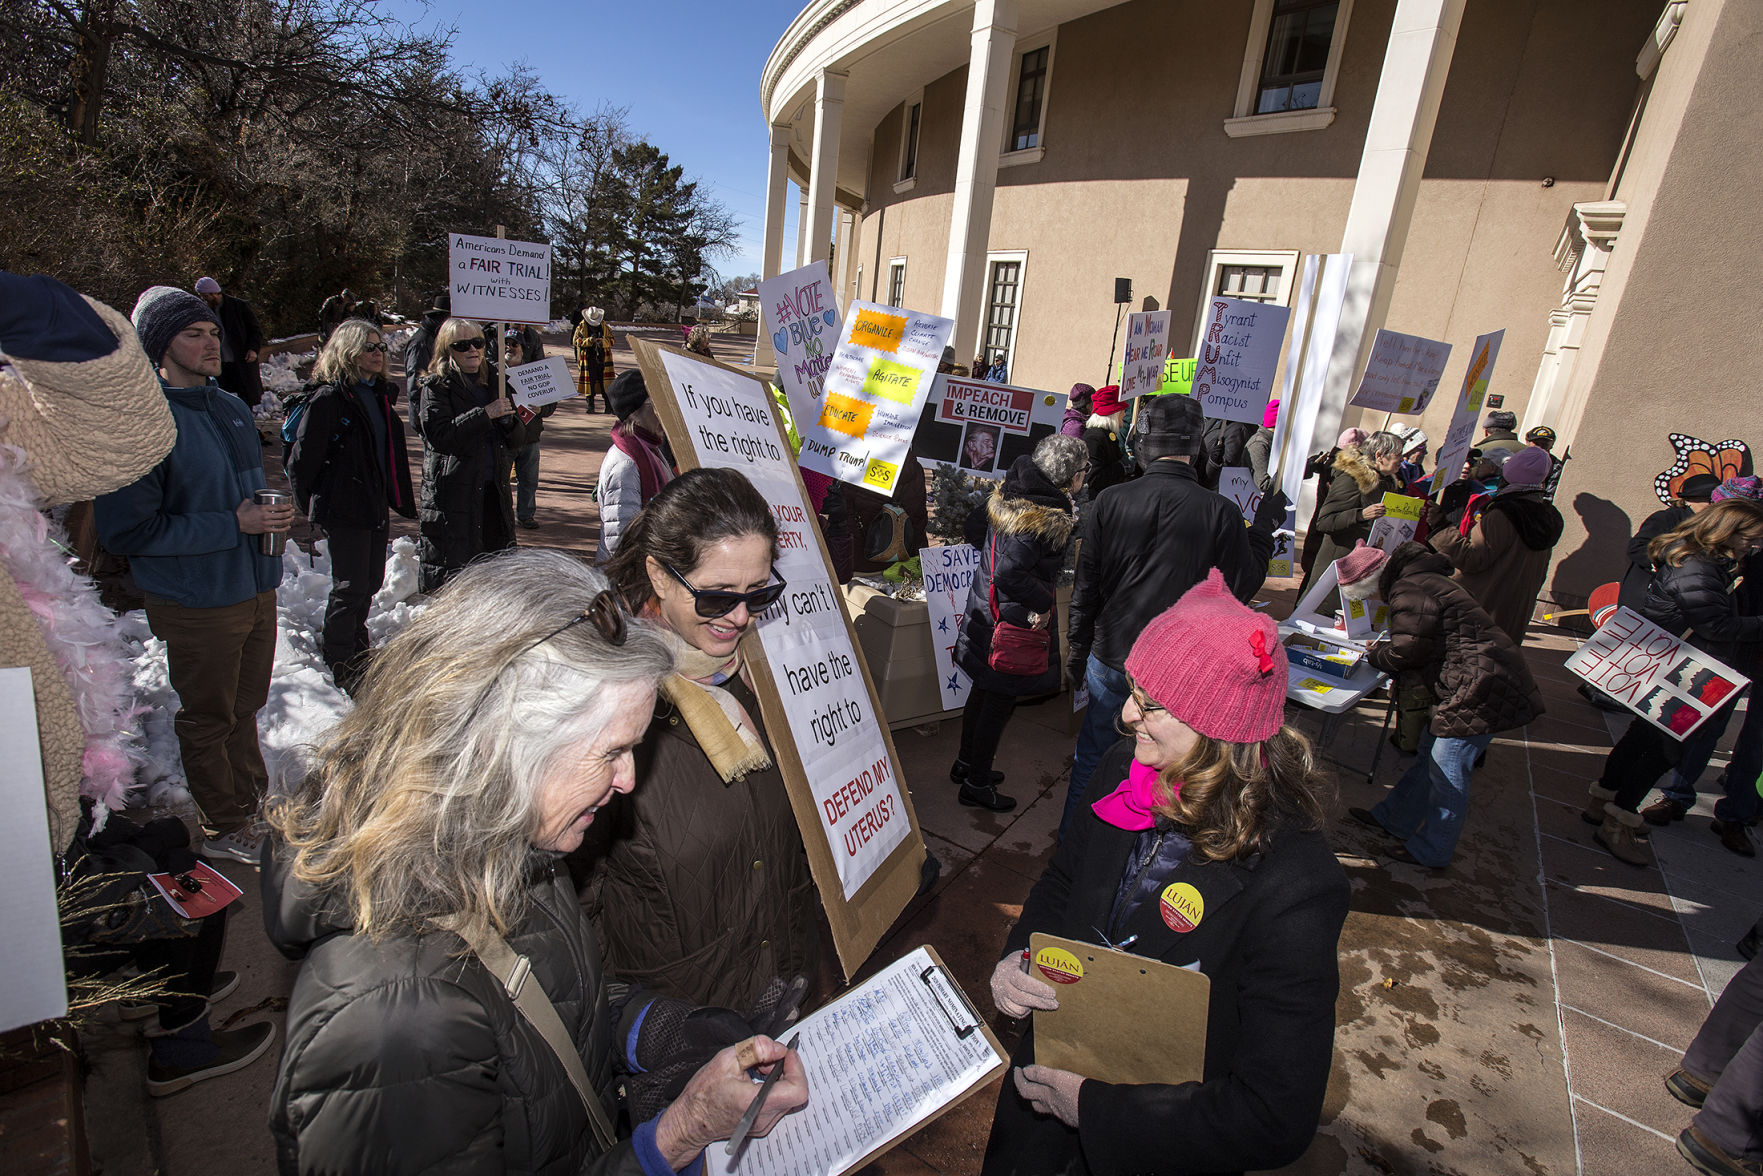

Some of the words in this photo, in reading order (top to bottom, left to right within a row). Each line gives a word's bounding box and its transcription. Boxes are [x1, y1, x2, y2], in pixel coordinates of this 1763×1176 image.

[455, 237, 506, 255] Americans
[509, 244, 546, 260] Demand
[470, 258, 500, 273] FAIR
[506, 261, 550, 280] TRIAL!
[490, 277, 511, 285] with
[457, 282, 548, 302] WITNESSES!
[776, 280, 824, 323] #VOTE
[1144, 314, 1164, 337] WOMAN
[1213, 301, 1257, 329] Tyrant
[1207, 323, 1252, 348] Racist
[803, 337, 823, 359] NO
[1124, 342, 1141, 366] HEAR
[1140, 346, 1149, 360] ME
[1148, 338, 1163, 361] ROAR
[1204, 345, 1242, 368] Unfit
[517, 366, 544, 377] DEMAND
[794, 353, 833, 384] Matte
[872, 368, 912, 387] AGITATE
[1196, 365, 1261, 392] Misogynist
[520, 377, 534, 386] FAIR
[538, 381, 551, 389] GOP
[681, 383, 698, 409] If
[699, 393, 733, 419] you
[731, 396, 770, 426] have
[946, 384, 1010, 407] IMPEACH
[1196, 383, 1248, 412] Pompus
[824, 404, 859, 422] EDUCATE
[954, 402, 964, 415] &
[968, 404, 1026, 425] REMOVE
[698, 425, 729, 453] the
[730, 431, 767, 462] right
[764, 438, 781, 461] to
[807, 438, 836, 459] DUMP
[773, 504, 806, 523] YOUR
[942, 549, 980, 568] SAVE
[925, 569, 976, 593] DEMOCR
[792, 583, 830, 615] can't
[826, 583, 838, 610] I
[1608, 612, 1681, 666] VOTE
[1590, 630, 1660, 684] VOTE
[783, 661, 830, 695] have
[827, 650, 852, 680] the
[1573, 650, 1641, 703] VOTE
[810, 700, 848, 747] right
[844, 697, 861, 725] to
[823, 769, 874, 827] DEFEND
[872, 755, 890, 787] MY
[843, 793, 895, 857] UTERUS?
[1166, 888, 1201, 920] LUJÁN
